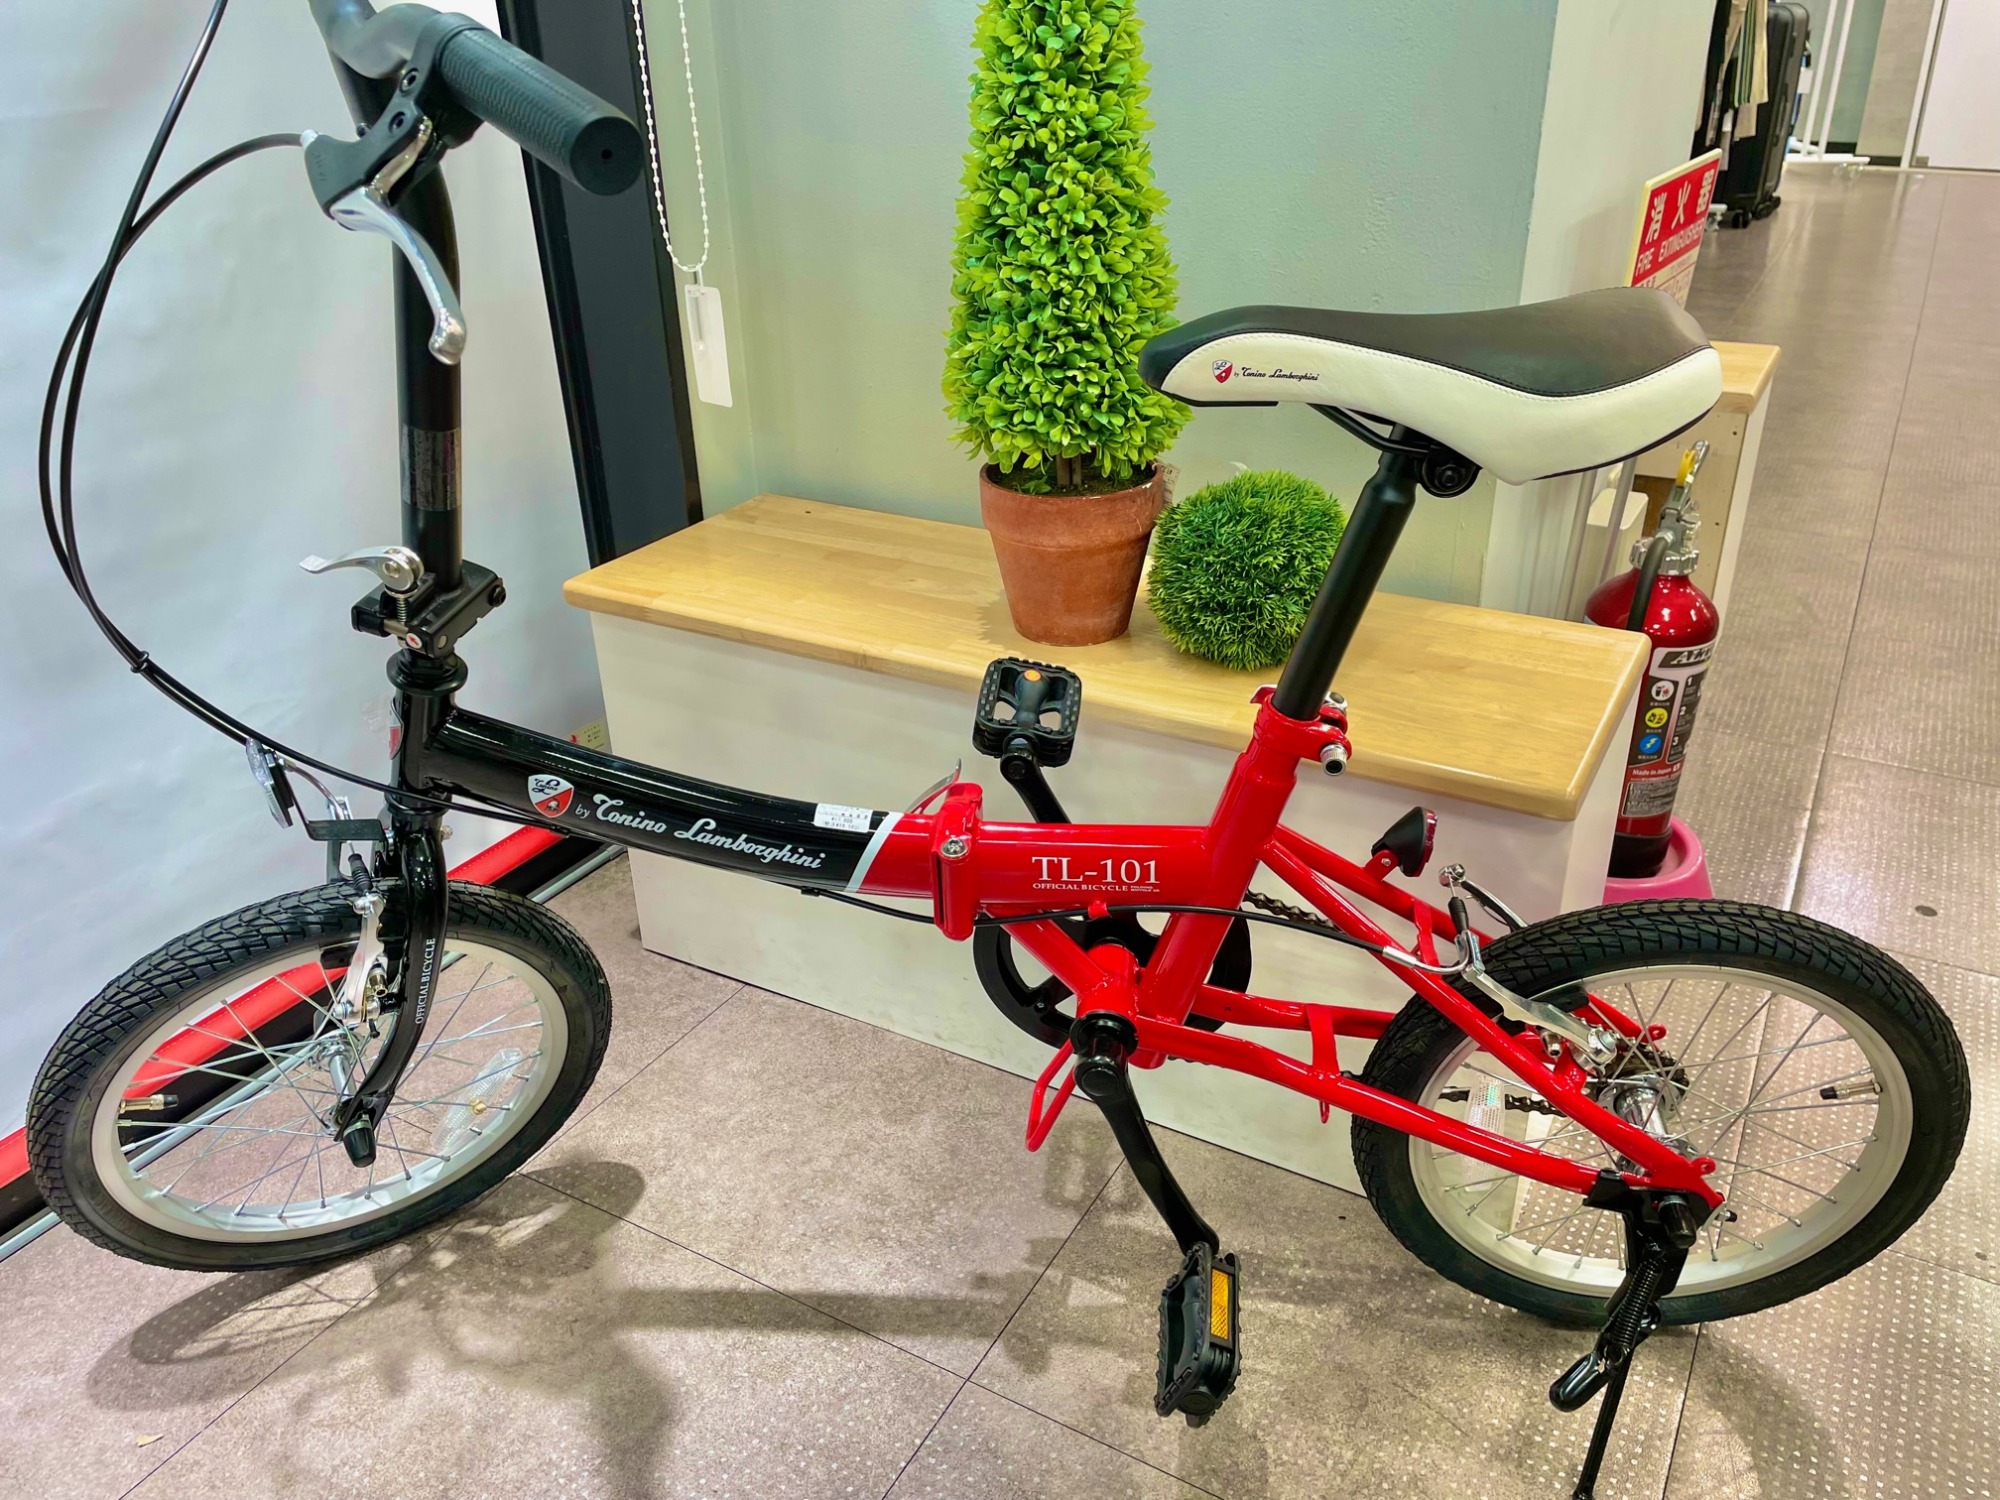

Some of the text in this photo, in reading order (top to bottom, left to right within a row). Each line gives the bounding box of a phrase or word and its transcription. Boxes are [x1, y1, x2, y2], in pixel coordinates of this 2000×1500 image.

[1645, 168, 1715, 245] 消火器
[1635, 247, 1655, 277] FIRE
[1241, 366, 1266, 378] Tonino
[1268, 368, 1320, 382] Lamborghini
[1687, 677, 1693, 686] 1
[1680, 706, 1687, 716] 2
[1672, 736, 1679, 746] 3
[575, 793, 826, 869] by Tonino Lamborghini
[1032, 856, 1160, 883] TL-101
[1032, 883, 1129, 892] OFFICIAL BICYCLE
